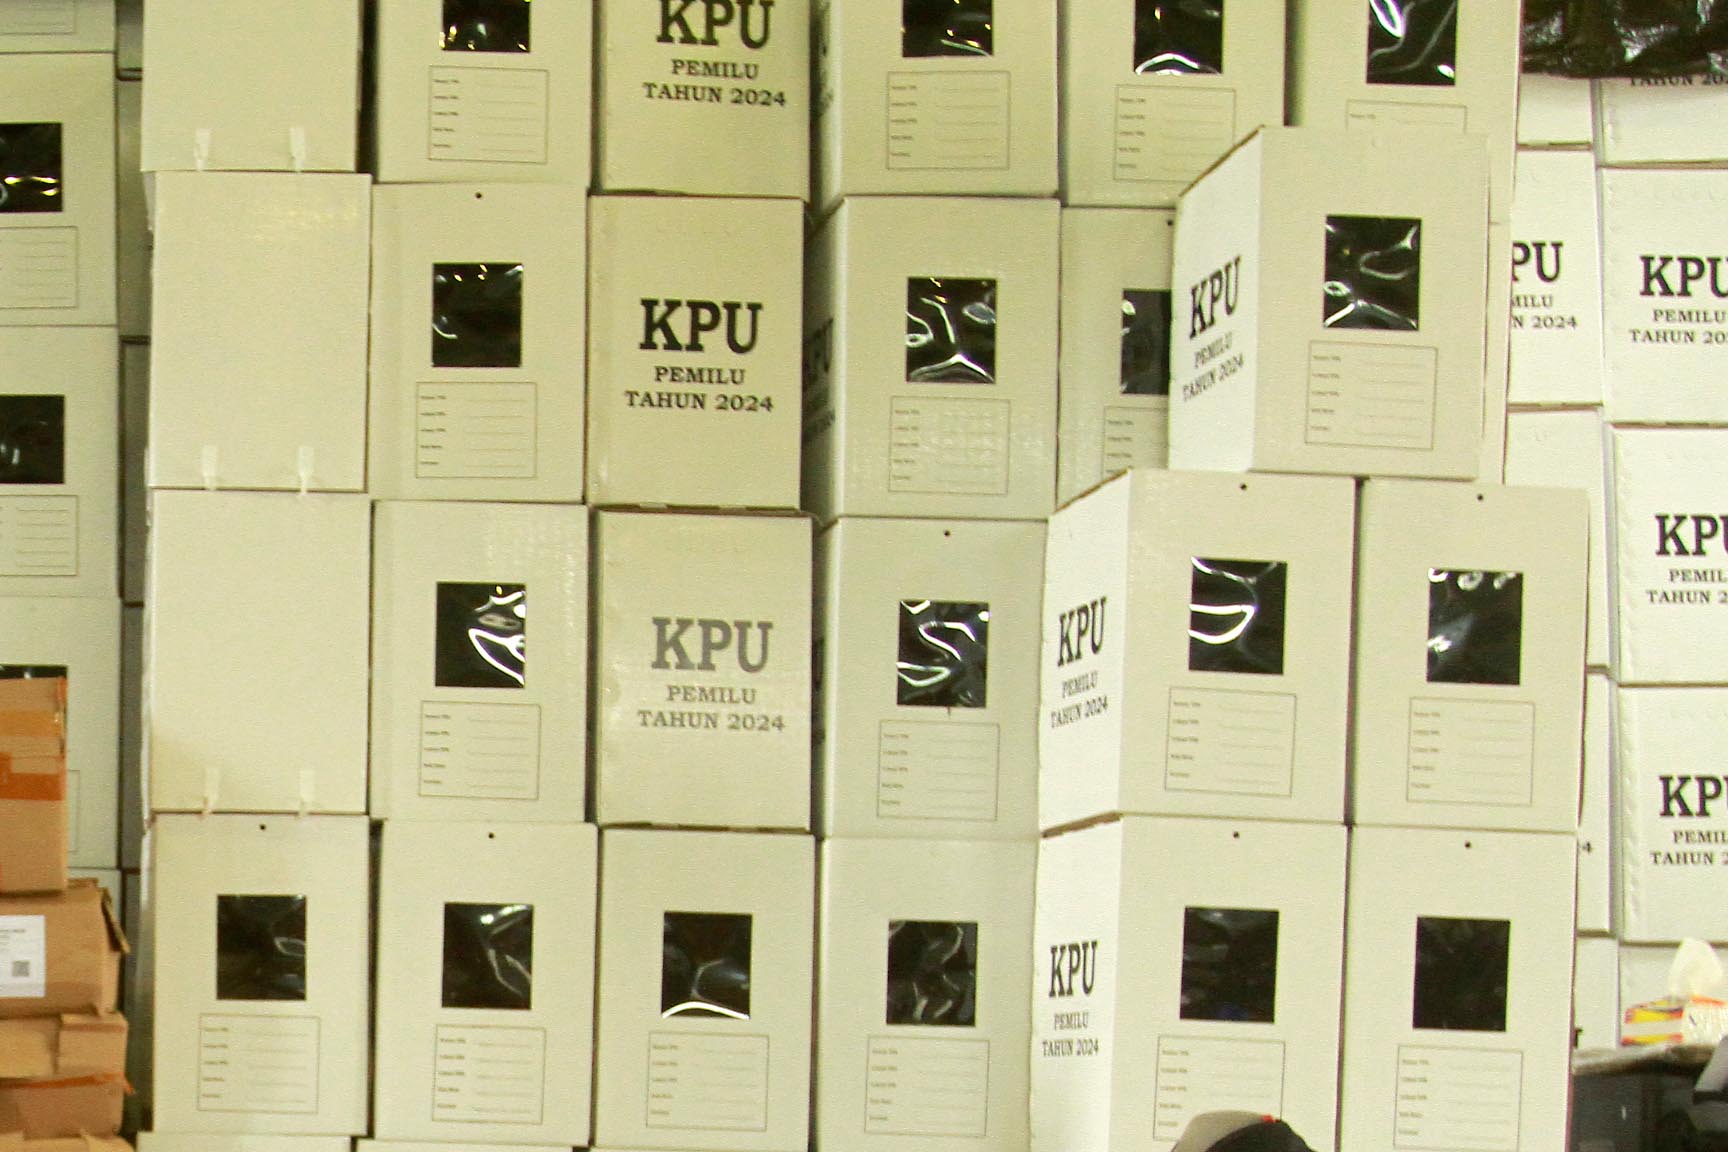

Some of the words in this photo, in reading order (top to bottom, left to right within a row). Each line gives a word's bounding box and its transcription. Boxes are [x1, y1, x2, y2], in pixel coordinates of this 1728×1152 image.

[656, 0, 774, 49] KPU
[671, 59, 759, 79] PEMILU
[642, 82, 722, 103] TAHUN
[730, 88, 786, 107] 2024
[1512, 241, 1563, 283] PU
[1189, 255, 1242, 339] KPU
[1511, 294, 1553, 308] MILU
[639, 298, 763, 354] KPU
[1532, 315, 1577, 329] 2024
[1653, 308, 1727, 323] PEMILU
[1629, 328, 1696, 344] TAHUN
[1703, 331, 1728, 344] 20
[654, 365, 746, 385] PEMILU
[624, 390, 706, 410] TAHUN
[714, 393, 774, 411] 2024
[1655, 514, 1728, 557] KP
[1669, 568, 1728, 583] PEMIL
[1646, 589, 1710, 603] TAHUN
[1057, 596, 1107, 667] KPU
[651, 616, 775, 673] KPU
[666, 684, 758, 704] PEMILU
[1085, 695, 1108, 718] 2024
[637, 709, 719, 729] TAHUN
[727, 712, 786, 731] 2024
[1659, 775, 1728, 817] KP
[1673, 830, 1728, 844] PEMIL
[1650, 850, 1714, 865] TAHUN
[1049, 939, 1098, 998] KPU
[1053, 1010, 1089, 1031] PEMILU
[1042, 1038, 1074, 1057] TAHUN
[1076, 1038, 1099, 1057] 2024
